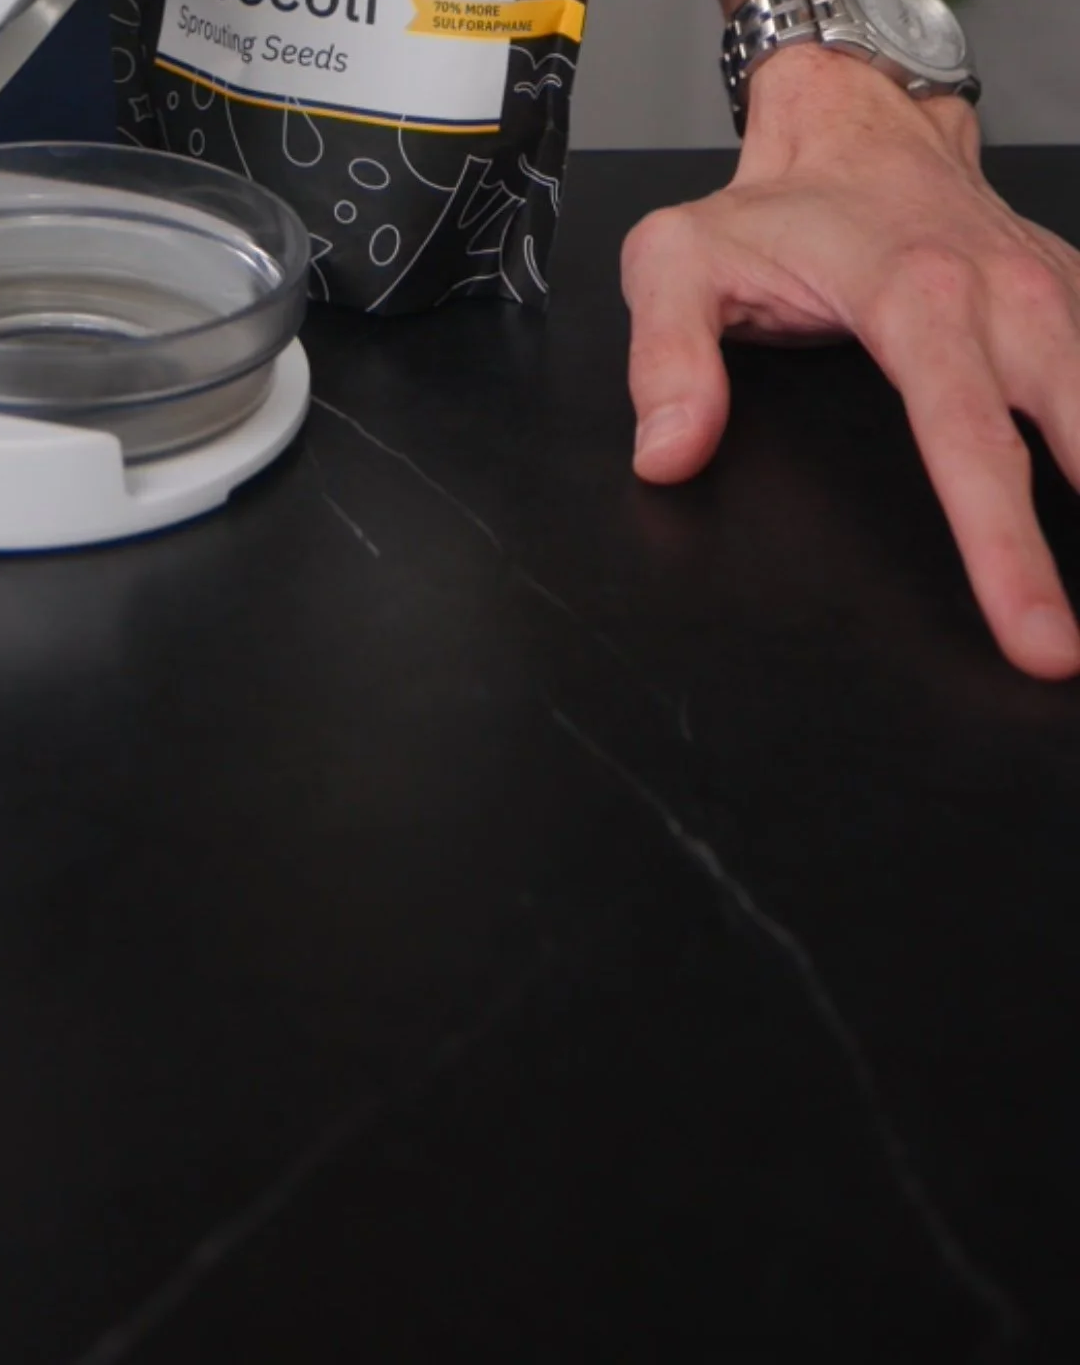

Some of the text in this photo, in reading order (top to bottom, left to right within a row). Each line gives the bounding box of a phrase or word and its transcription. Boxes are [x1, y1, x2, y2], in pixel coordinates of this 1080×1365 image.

[434, 0, 501, 16] 70% MORE
[432, 16, 533, 32] SULFORAPHANE
[177, 4, 349, 73] Sprouting Seeds
